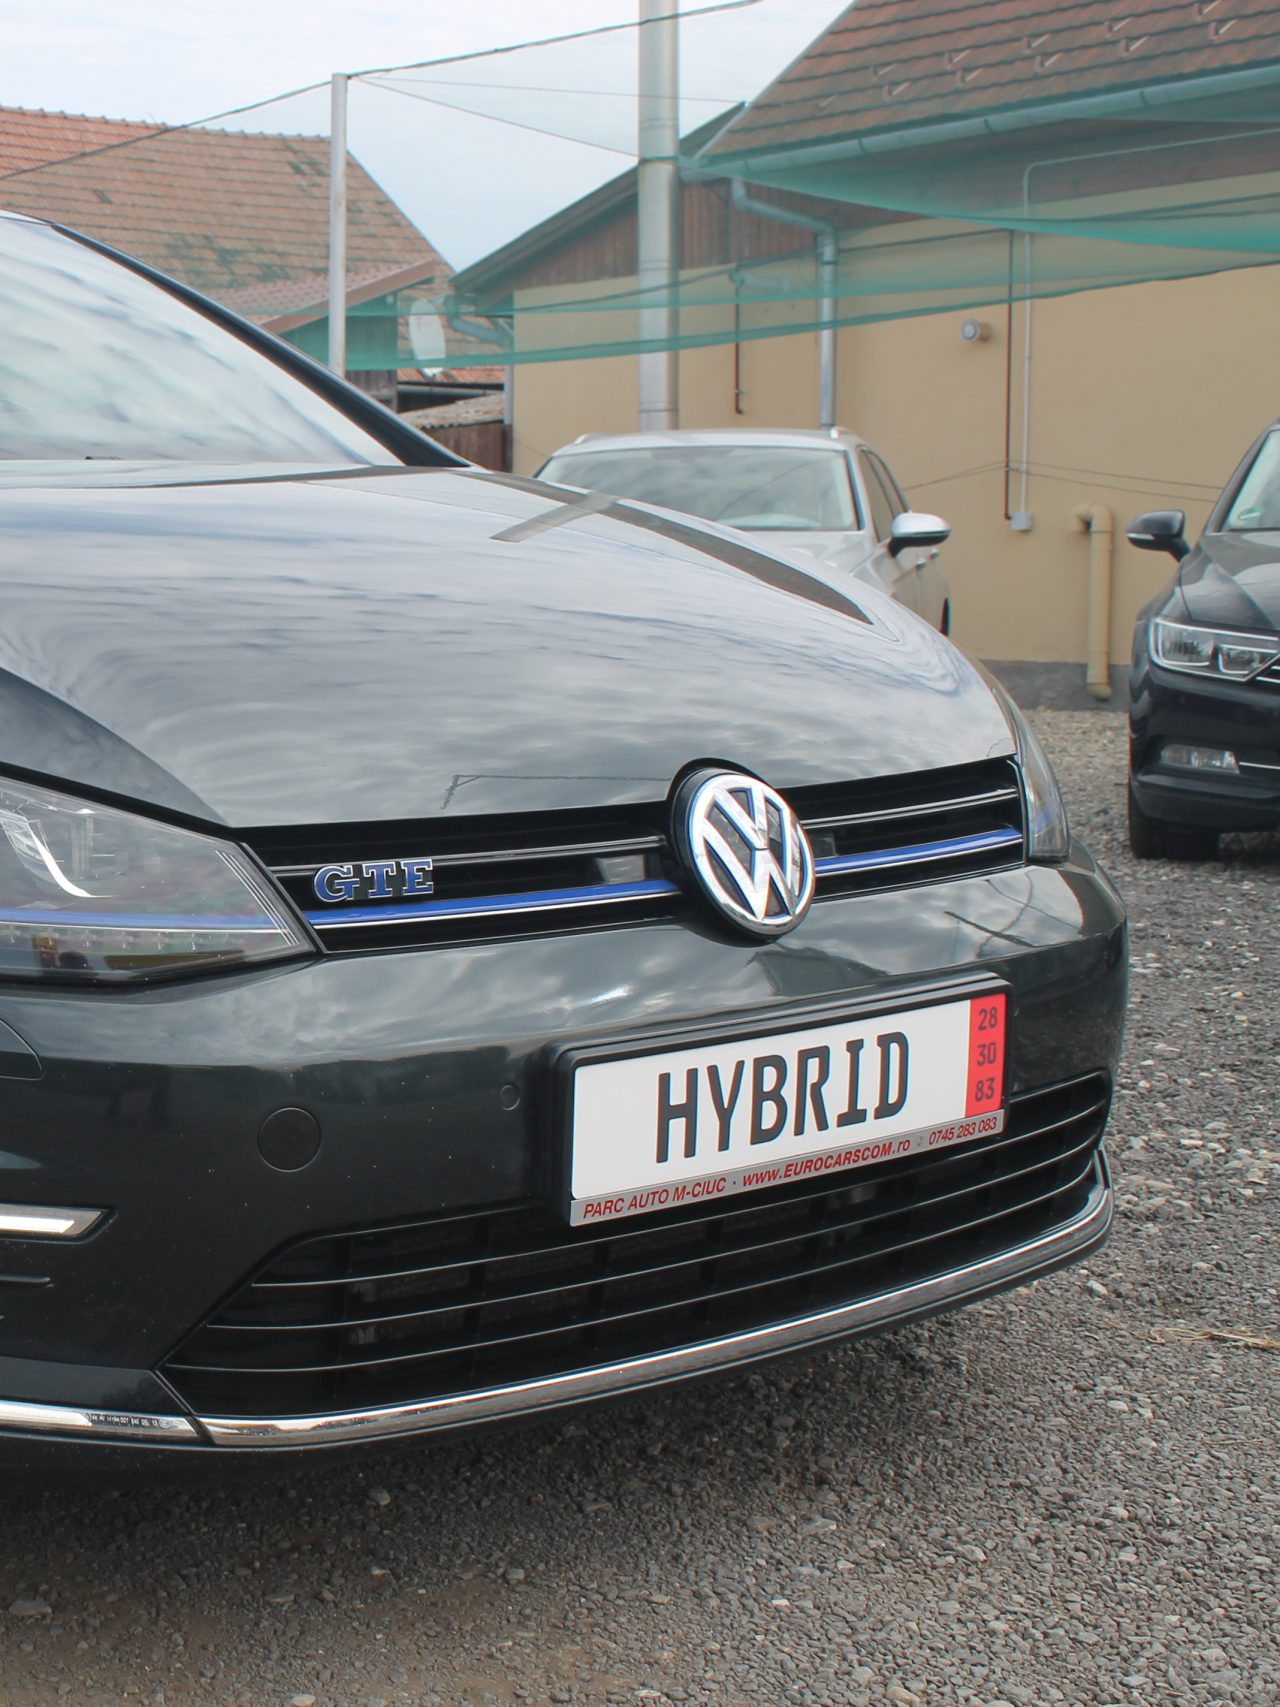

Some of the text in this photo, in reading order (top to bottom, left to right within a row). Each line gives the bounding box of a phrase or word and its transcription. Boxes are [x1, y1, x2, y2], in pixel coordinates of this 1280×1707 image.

[313, 858, 434, 902] GTE
[978, 1006, 998, 1031] 28
[976, 1041, 997, 1066] 30
[656, 1031, 909, 1164] HYBRID
[974, 1077, 996, 1102] 83
[583, 1199, 625, 1219] PARC
[627, 1189, 670, 1210] AUTO
[672, 1177, 727, 1201] M-CIUC
[928, 1127, 954, 1145] 0745
[956, 1121, 976, 1139] 283
[977, 1116, 997, 1134] 083
